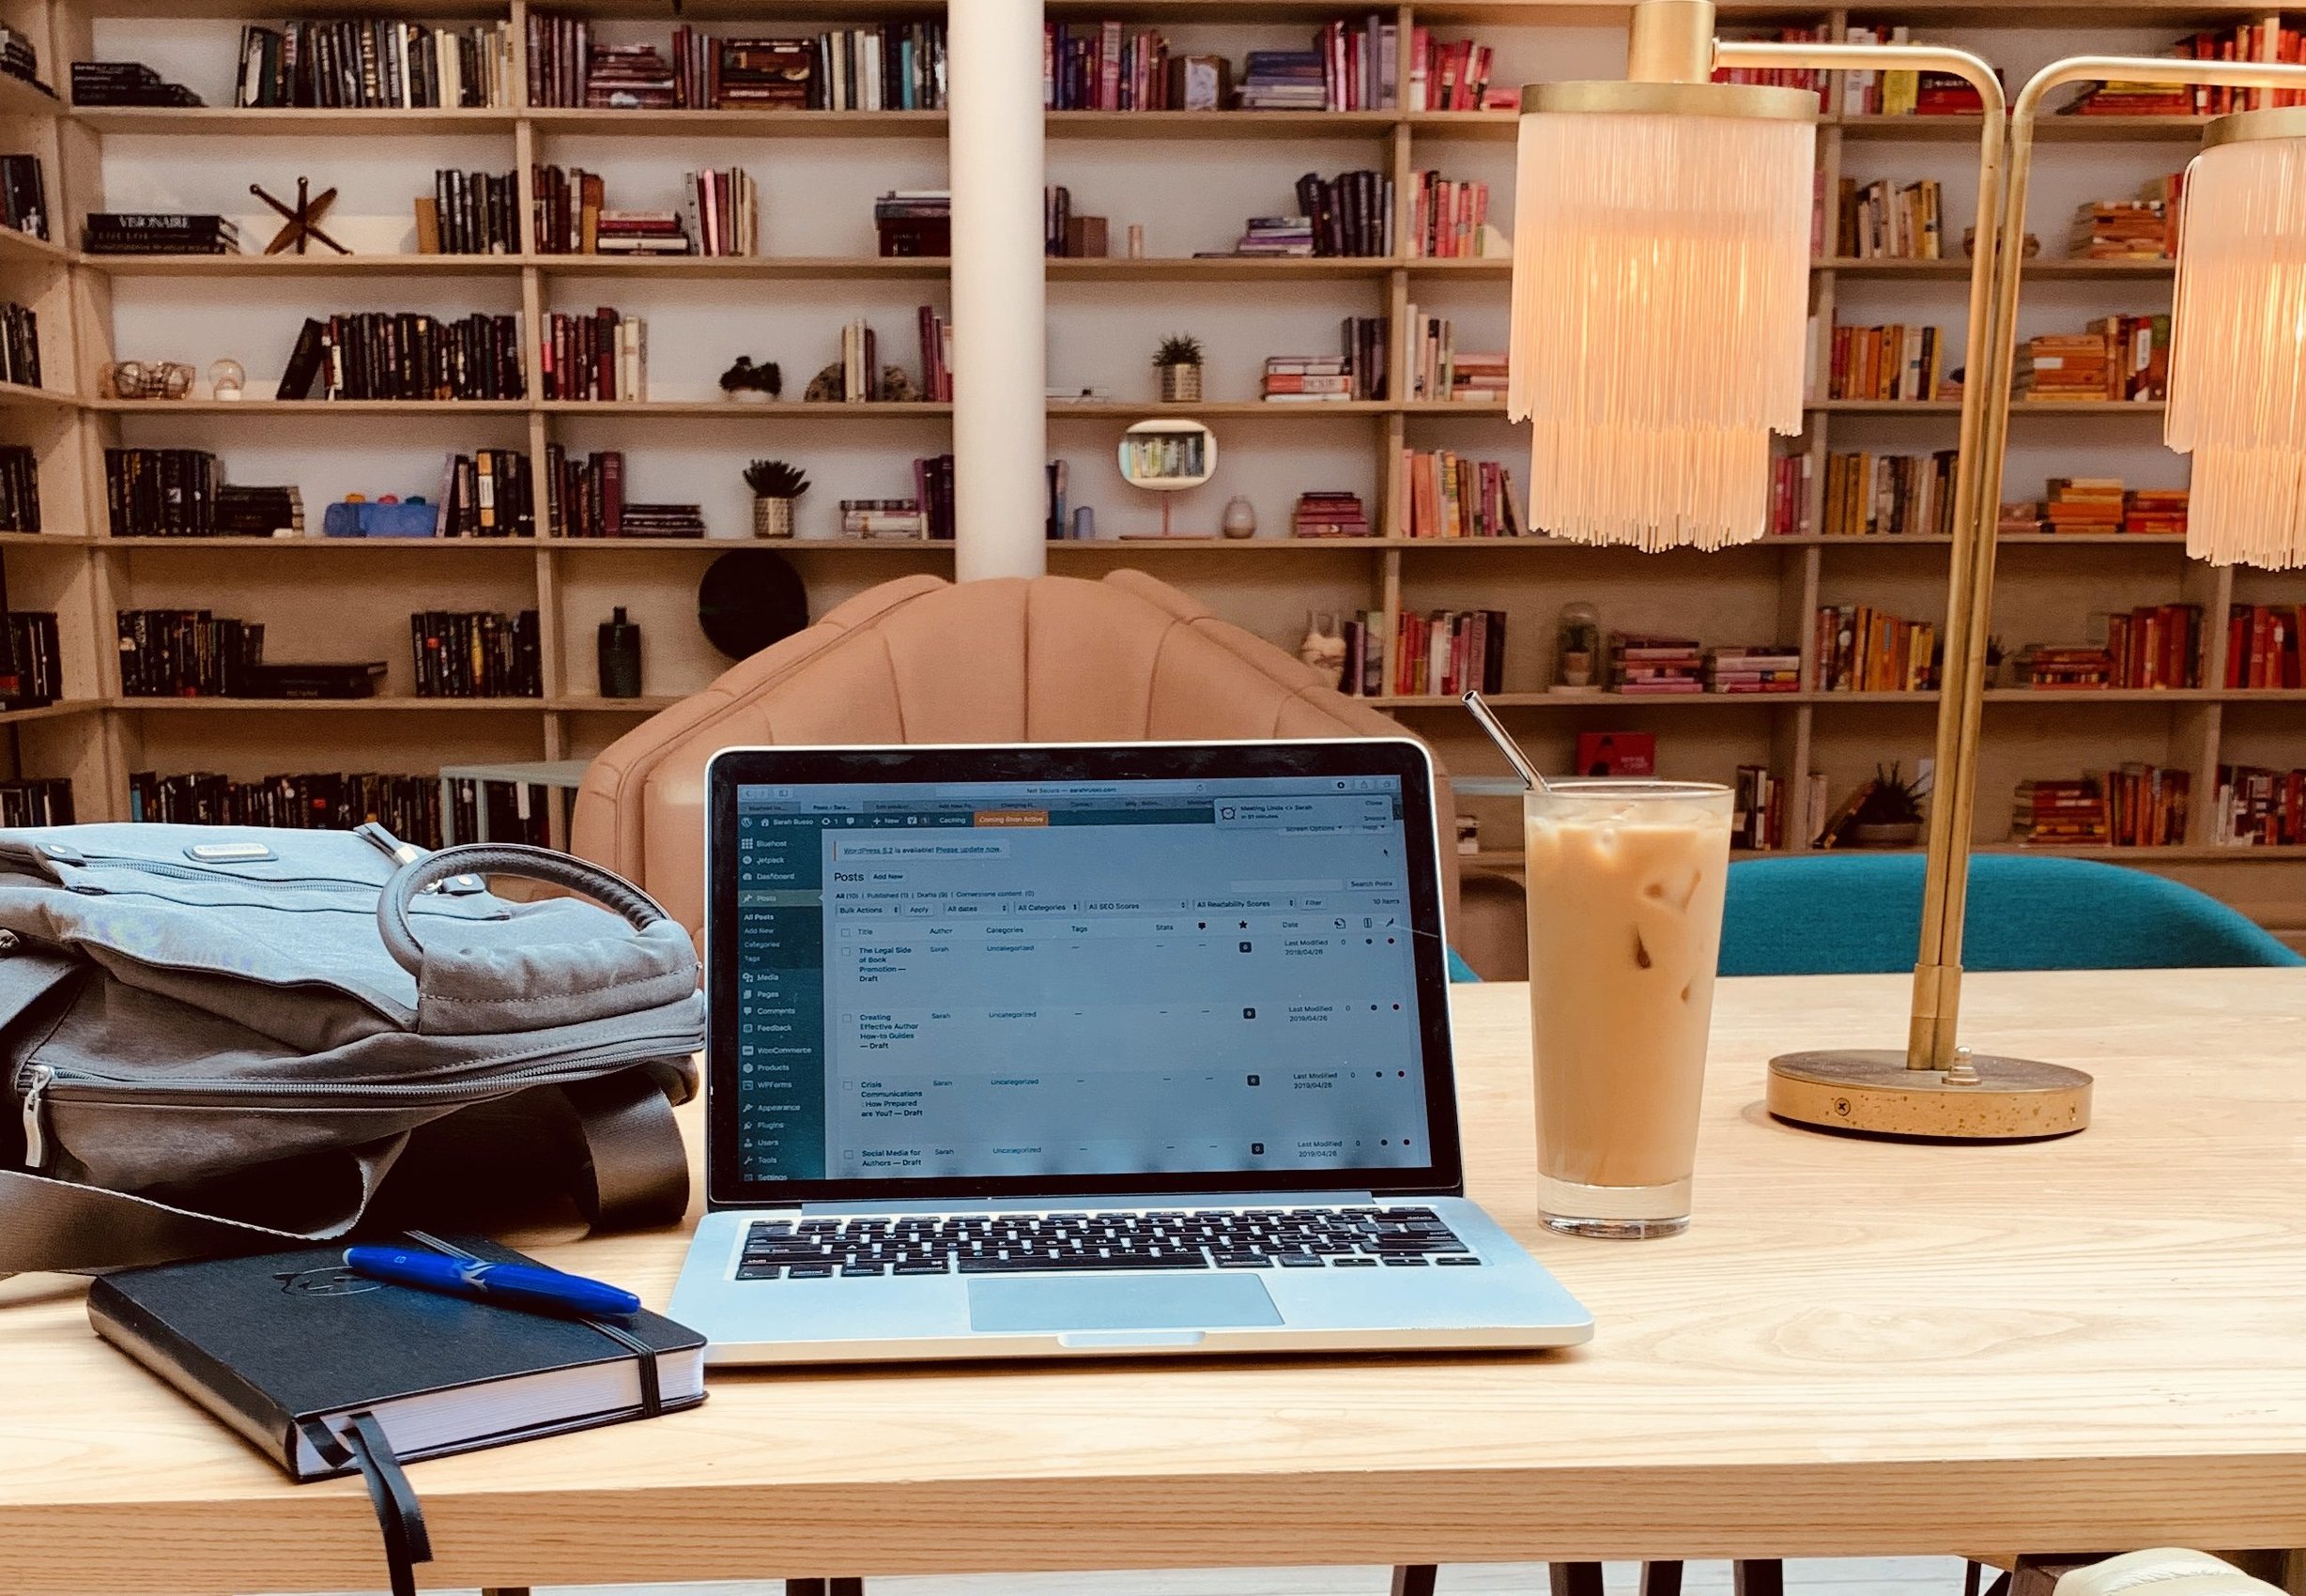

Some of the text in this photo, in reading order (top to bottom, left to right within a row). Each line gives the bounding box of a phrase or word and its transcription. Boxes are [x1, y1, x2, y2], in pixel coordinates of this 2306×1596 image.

[119, 216, 189, 228] VISIONAIRE
[834, 872, 865, 882] Posts
[1028, 904, 1066, 913] Categories
[1207, 900, 1244, 909] Readability
[986, 927, 1023, 935] Categories
[874, 946, 894, 956] Legal
[986, 944, 1035, 953] Uncategorized
[757, 990, 779, 999] Pages
[884, 1099, 917, 1108] Prepared
[757, 1104, 801, 1113] Appearance
[757, 1121, 785, 1130] Plugins
